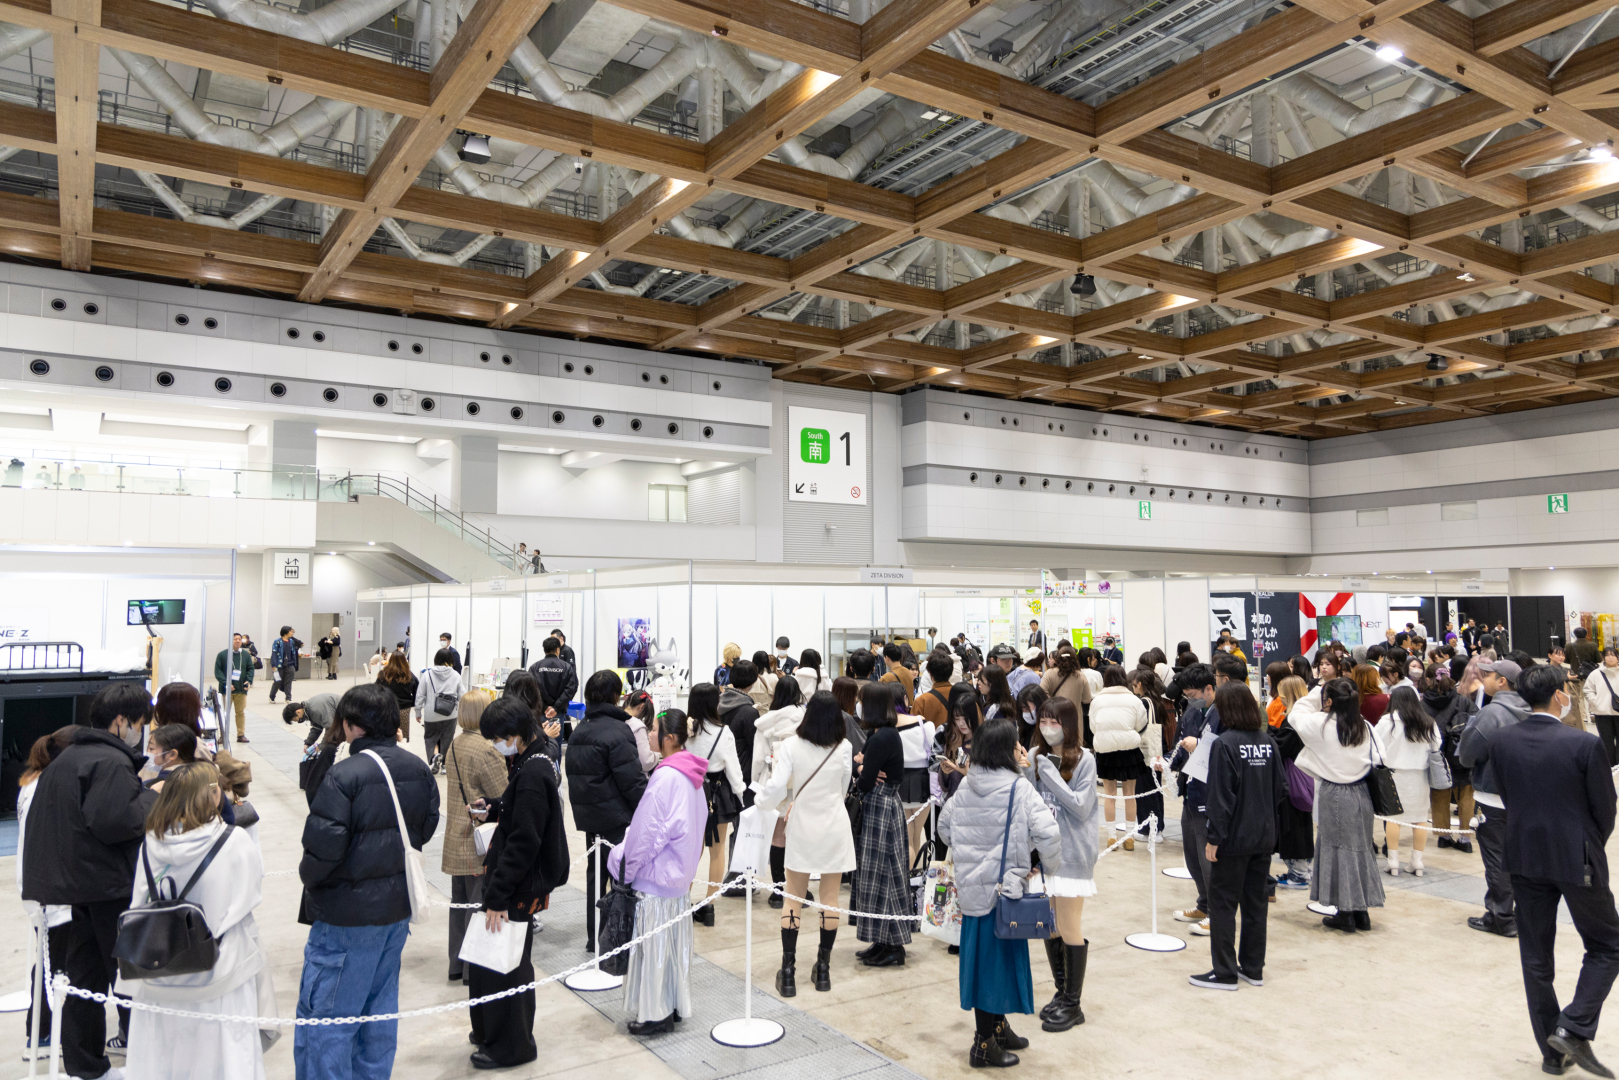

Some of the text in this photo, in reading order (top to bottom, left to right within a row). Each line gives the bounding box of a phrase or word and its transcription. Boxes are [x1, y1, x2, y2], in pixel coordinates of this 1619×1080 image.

[807, 431, 824, 440] South
[808, 441, 822, 461] 南
[839, 431, 851, 466] 1
[1239, 744, 1272, 759] STAFF
